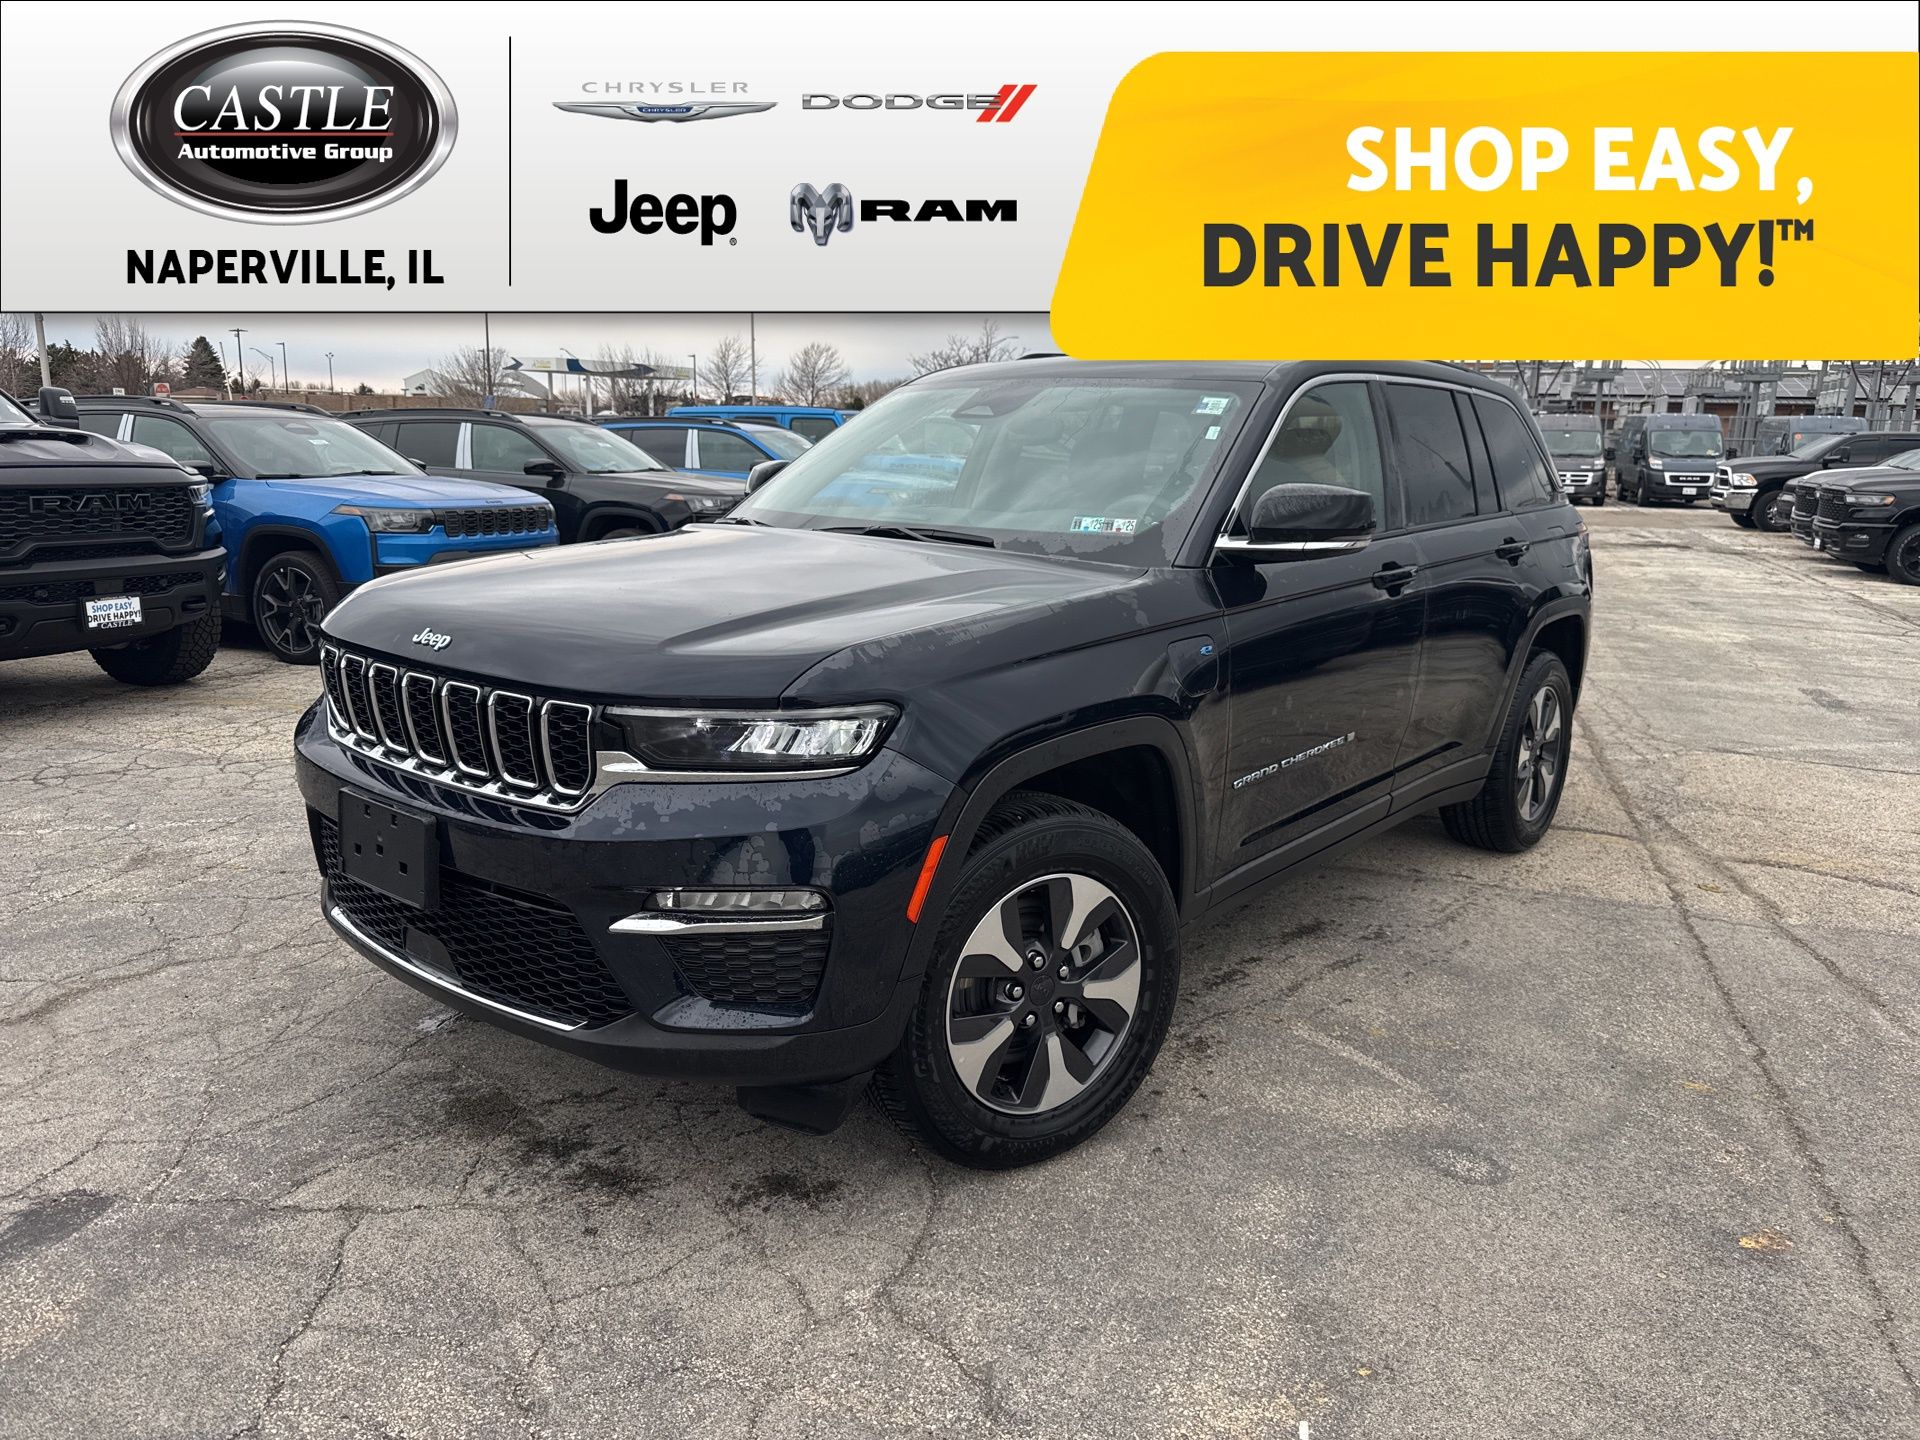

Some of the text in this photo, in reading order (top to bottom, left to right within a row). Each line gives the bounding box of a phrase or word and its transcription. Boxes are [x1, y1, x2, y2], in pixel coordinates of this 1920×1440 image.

[29, 493, 151, 513] RAM
[91, 601, 135, 613] SHOP EASY,
[88, 609, 141, 623] DRIVE HAPPY!
[101, 620, 133, 629] CASTLE
[412, 627, 452, 652] Jeep
[1232, 735, 1346, 790] GRAND CHEROKEE
